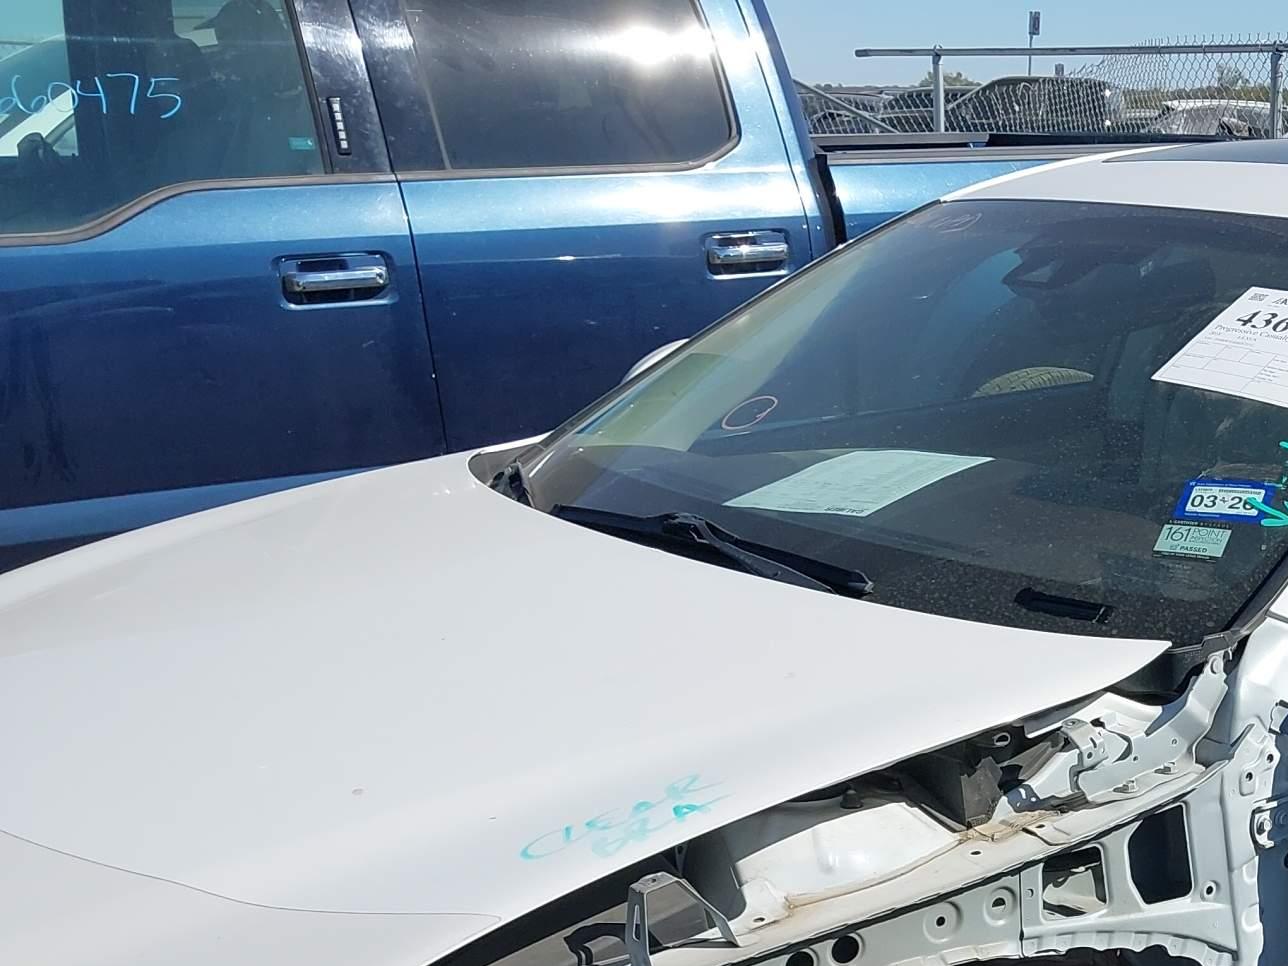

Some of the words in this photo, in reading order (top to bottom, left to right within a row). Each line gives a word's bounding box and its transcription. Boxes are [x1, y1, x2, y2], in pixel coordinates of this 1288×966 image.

[1214, 323, 1259, 337] Progressive
[1190, 494, 1218, 508] 03
[1165, 526, 1192, 542] 161
[1191, 527, 1227, 538] POINT
[1179, 545, 1208, 553] PASSED
